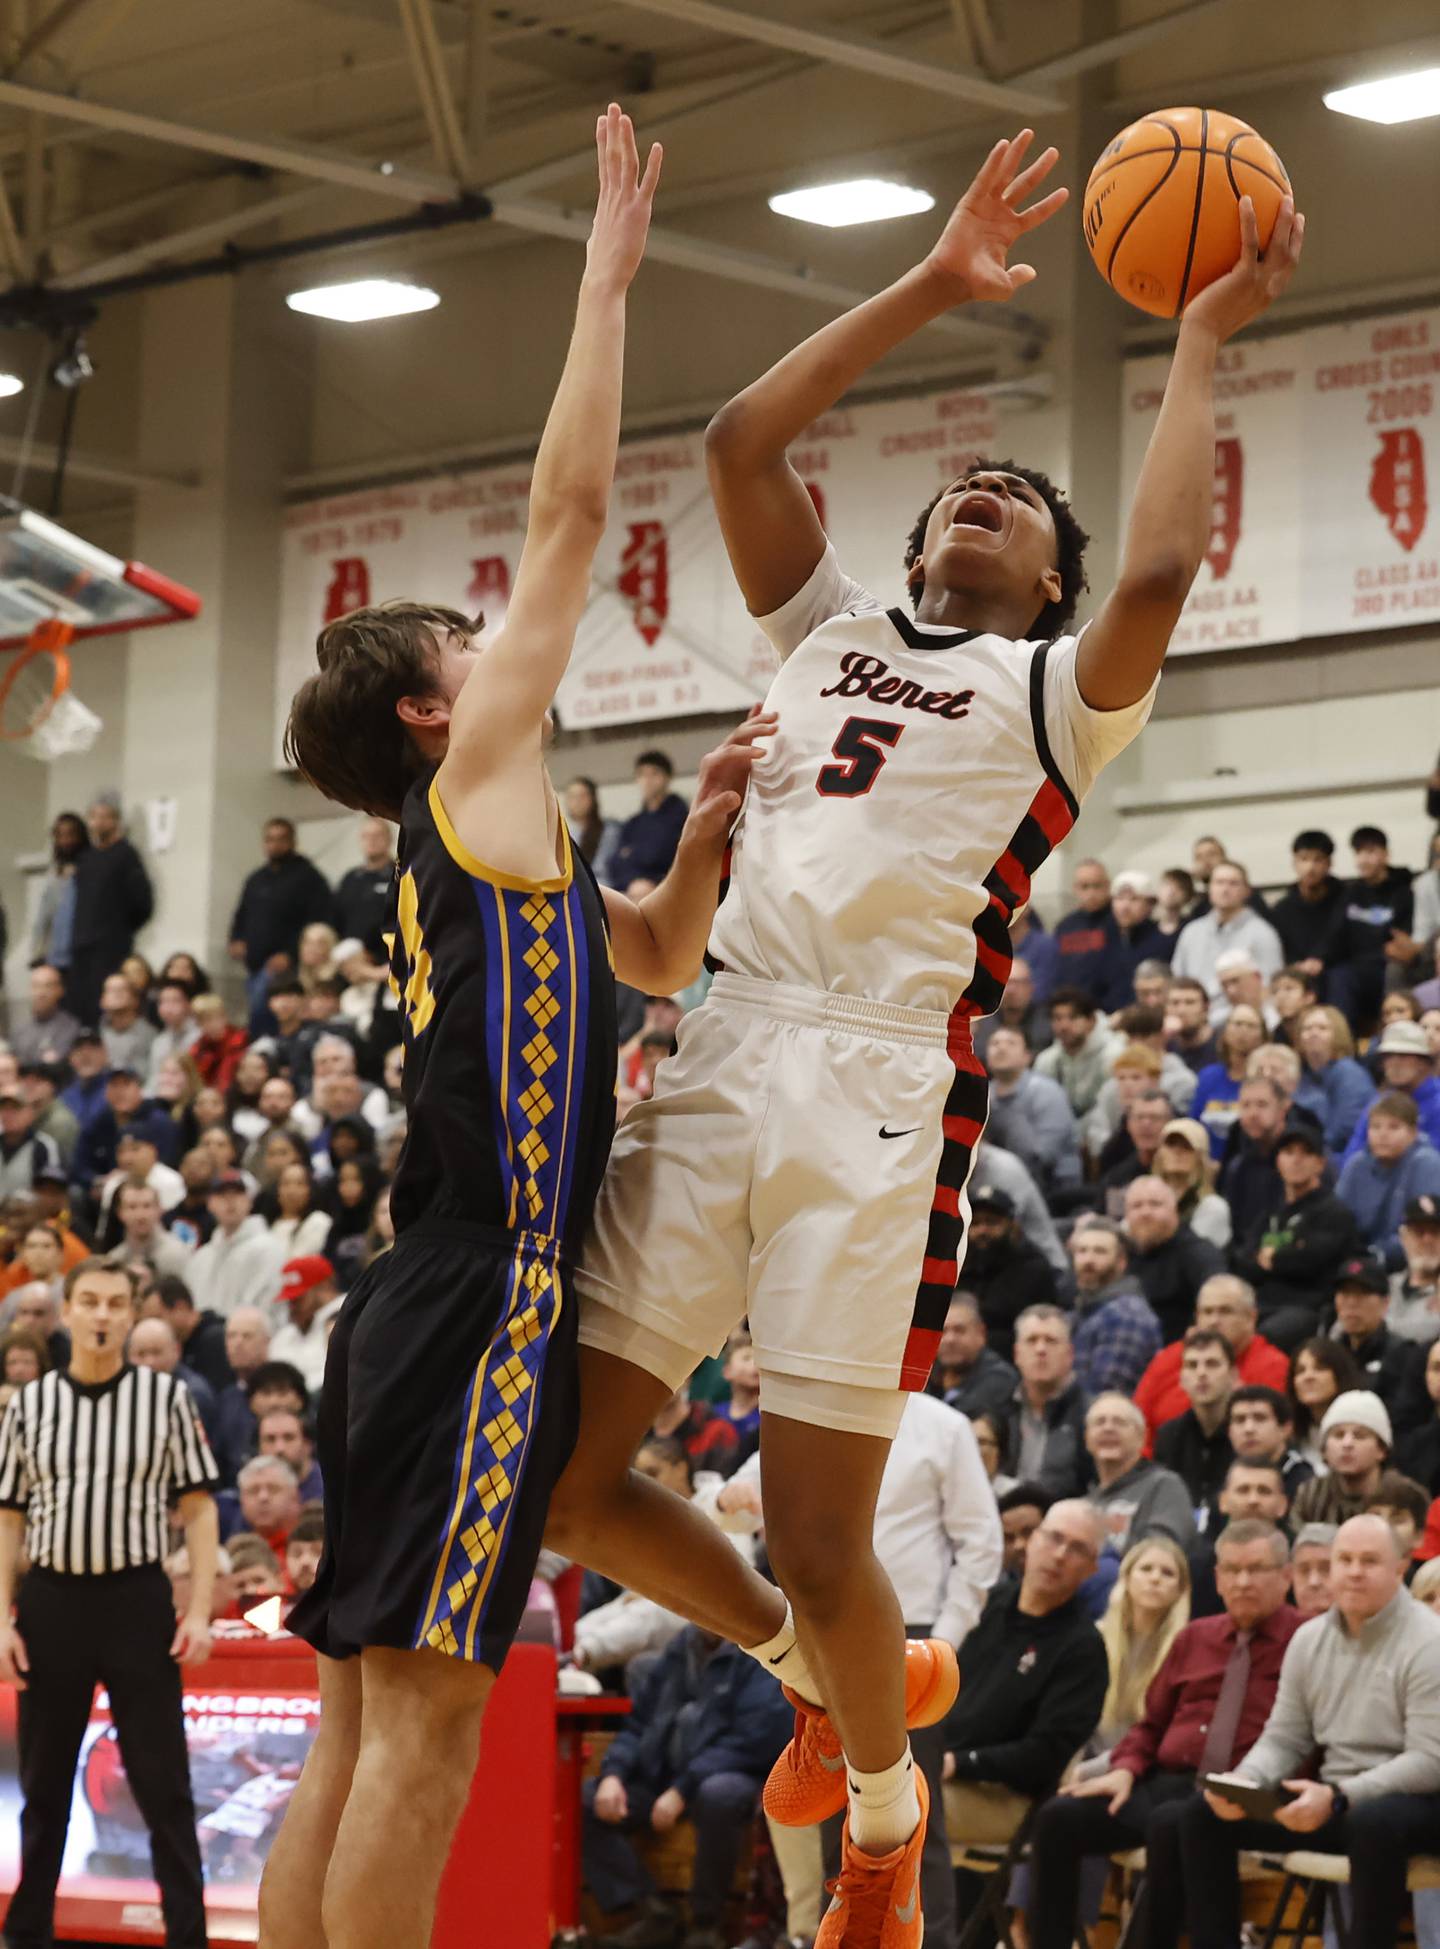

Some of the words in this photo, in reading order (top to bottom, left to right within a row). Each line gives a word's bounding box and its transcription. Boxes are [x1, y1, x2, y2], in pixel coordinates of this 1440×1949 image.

[1316, 360, 1382, 394] CROSS
[1366, 382, 1434, 425] 2006
[820, 651, 976, 720] Benet
[815, 715, 906, 799] 5
